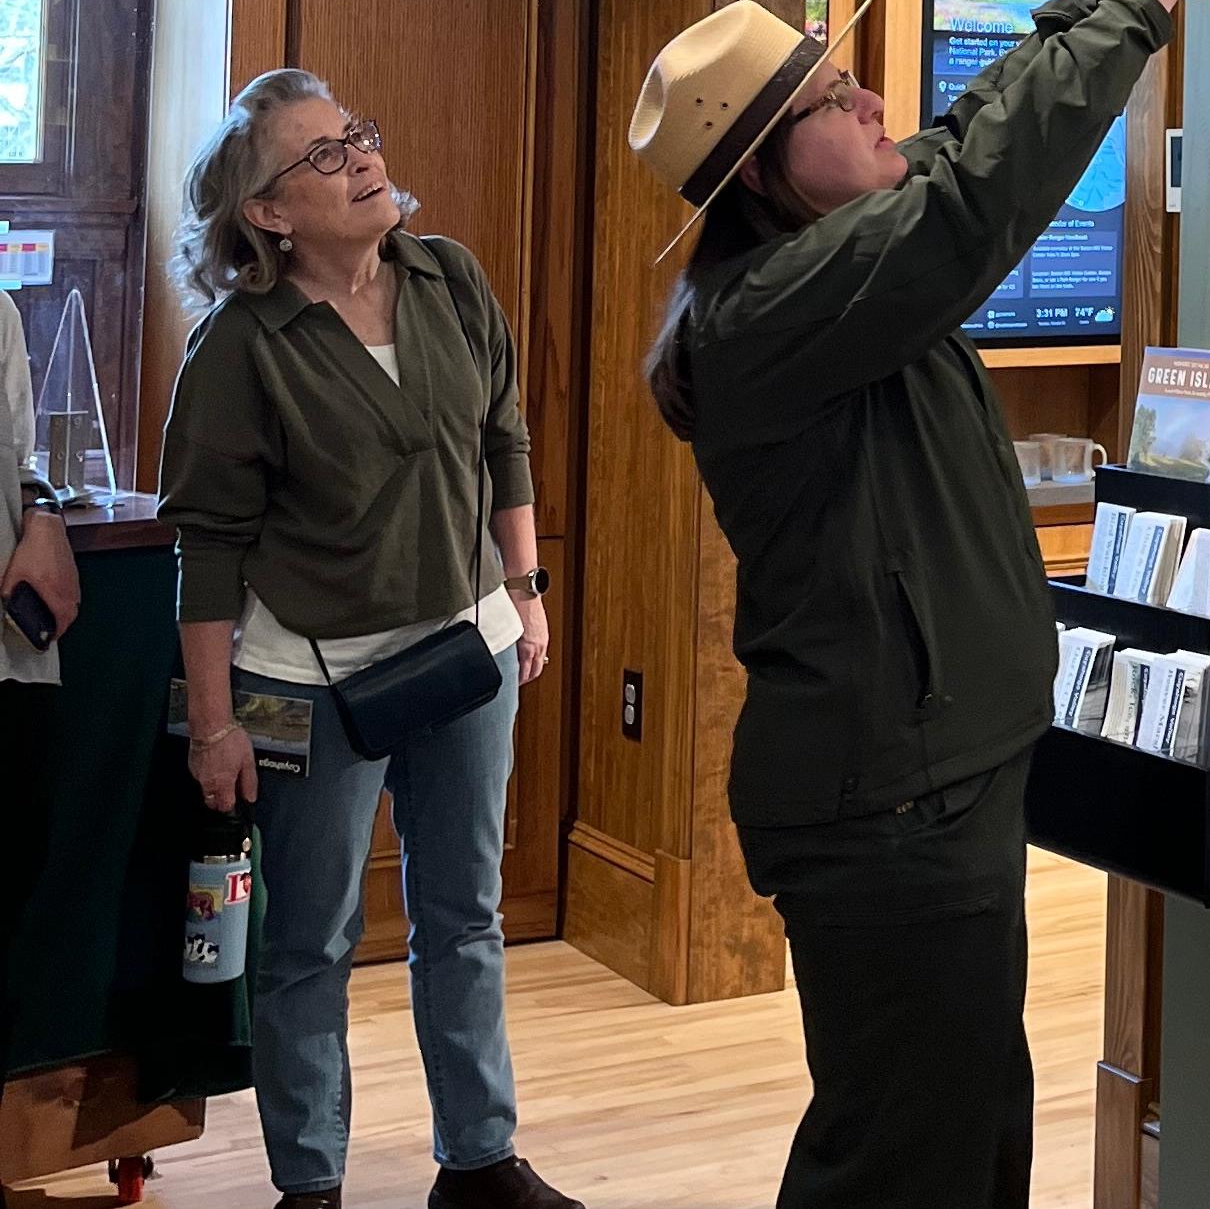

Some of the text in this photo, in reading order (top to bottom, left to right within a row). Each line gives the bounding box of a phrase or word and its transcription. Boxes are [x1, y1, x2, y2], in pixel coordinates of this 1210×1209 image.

[950, 17, 1014, 33] Welcome
[949, 37, 962, 45] Get
[964, 38, 987, 47] started
[1000, 40, 1016, 48] your
[1036, 309, 1068, 318] 3:31 PM
[1148, 367, 1186, 386] GREEN
[259, 758, 301, 773] Cuyahoga
